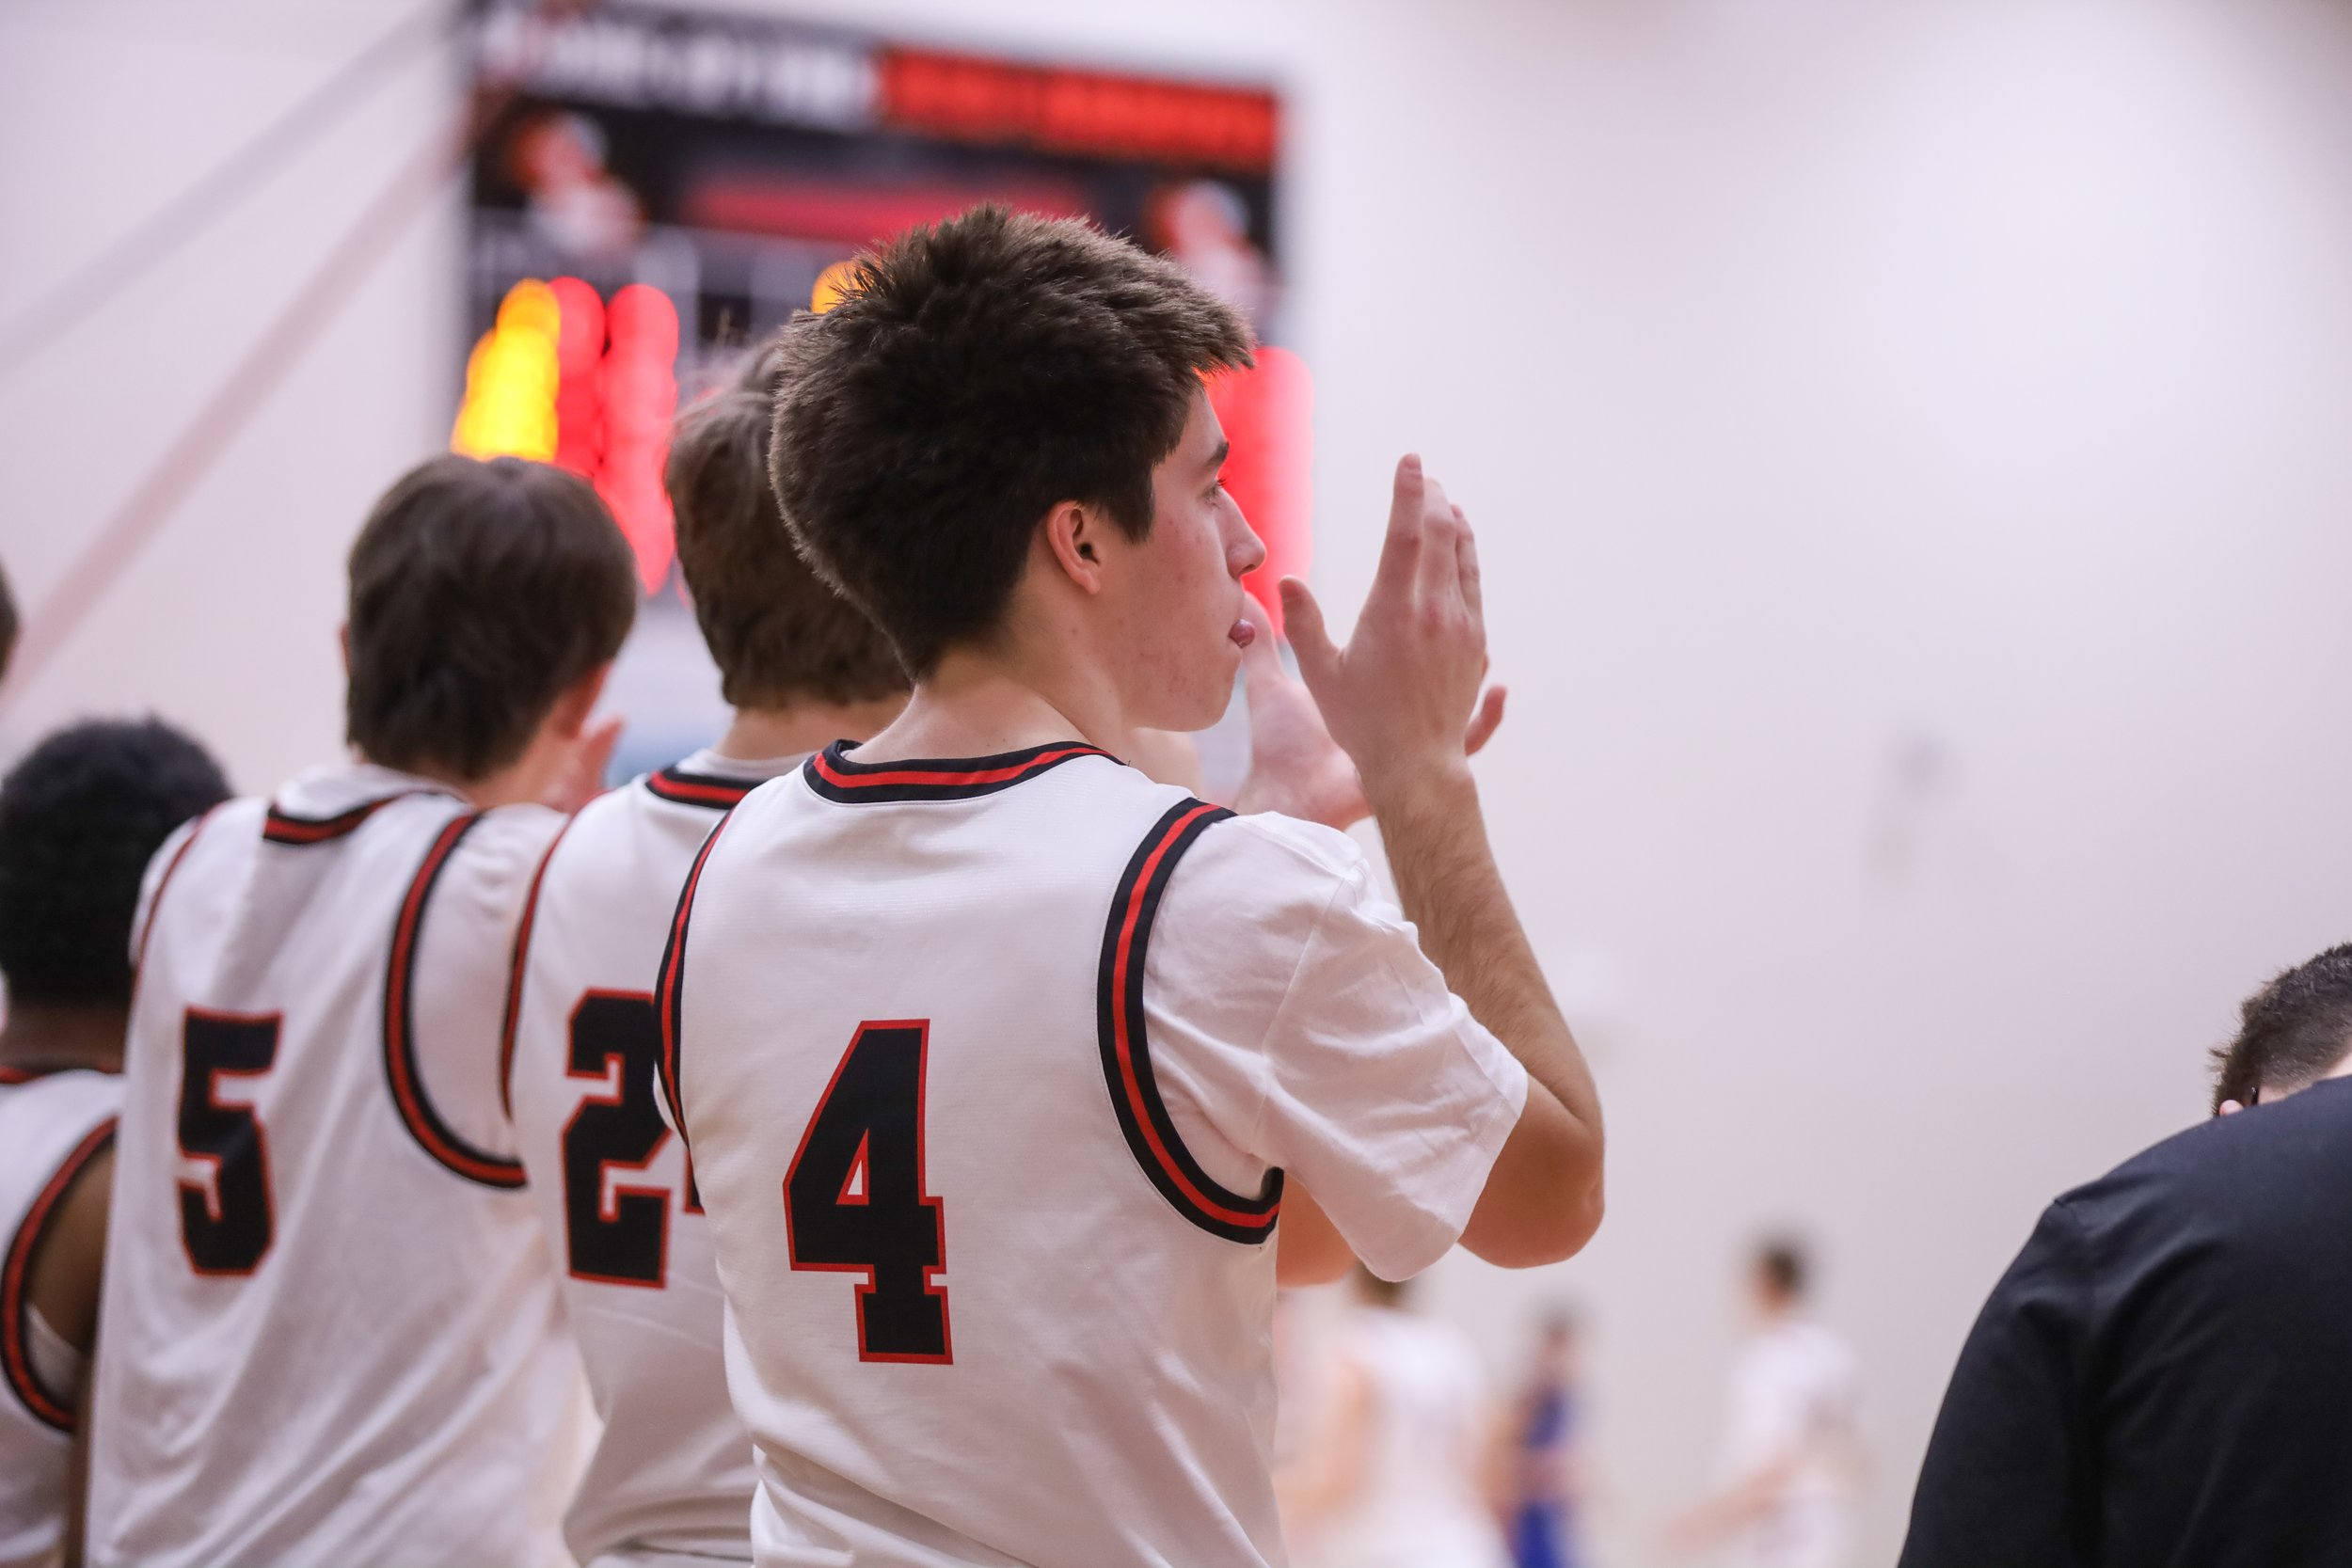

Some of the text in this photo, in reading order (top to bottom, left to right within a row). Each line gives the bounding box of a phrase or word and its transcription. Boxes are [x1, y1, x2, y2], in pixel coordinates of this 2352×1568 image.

[177, 1007, 283, 1277] 5
[563, 988, 705, 1288] 2
[783, 1019, 953, 1365] 4
